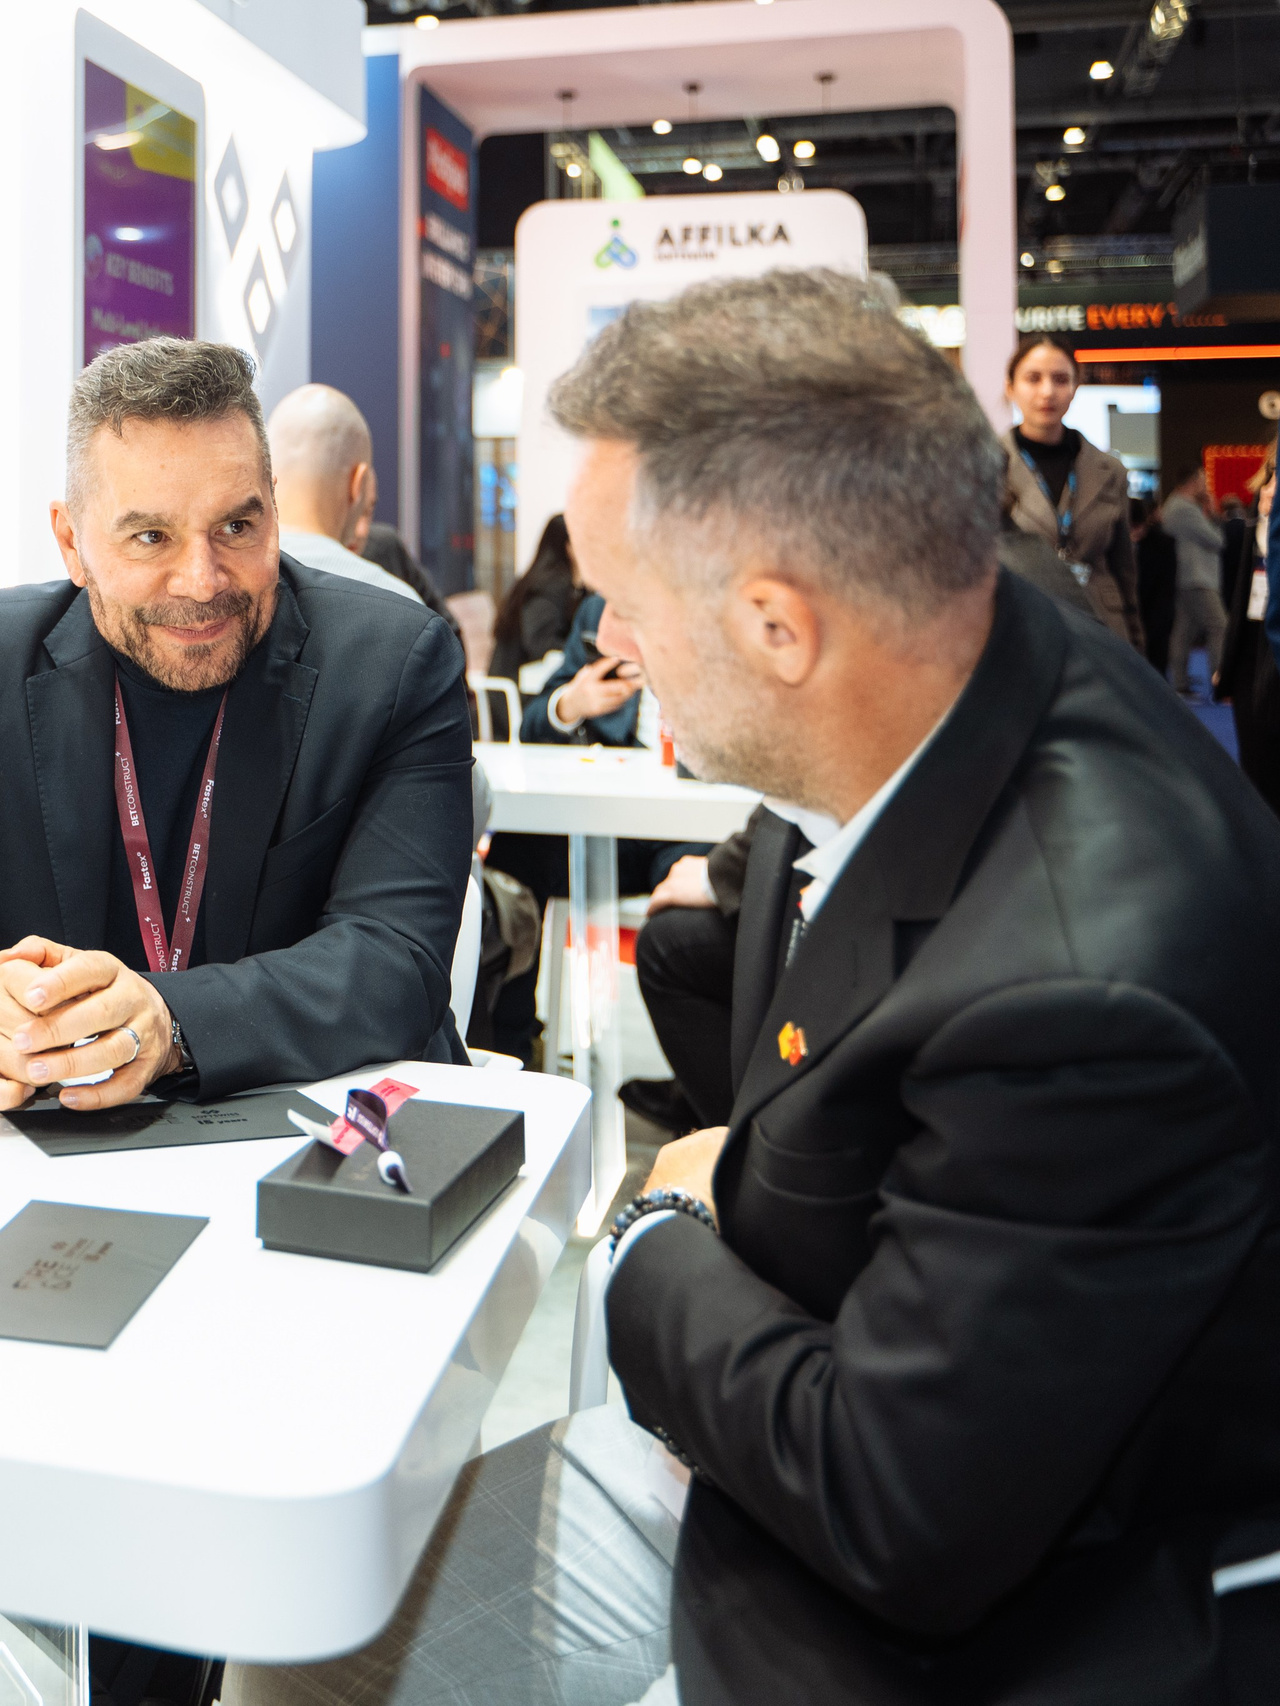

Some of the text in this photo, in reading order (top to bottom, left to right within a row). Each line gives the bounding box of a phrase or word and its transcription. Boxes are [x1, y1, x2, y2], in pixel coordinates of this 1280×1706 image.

[656, 224, 792, 247] AFFILKA
[1087, 302, 1165, 330] EVERY
[121, 757, 140, 827] BETCONSTRUCT
[182, 843, 201, 915] BETCONSTRUCT
